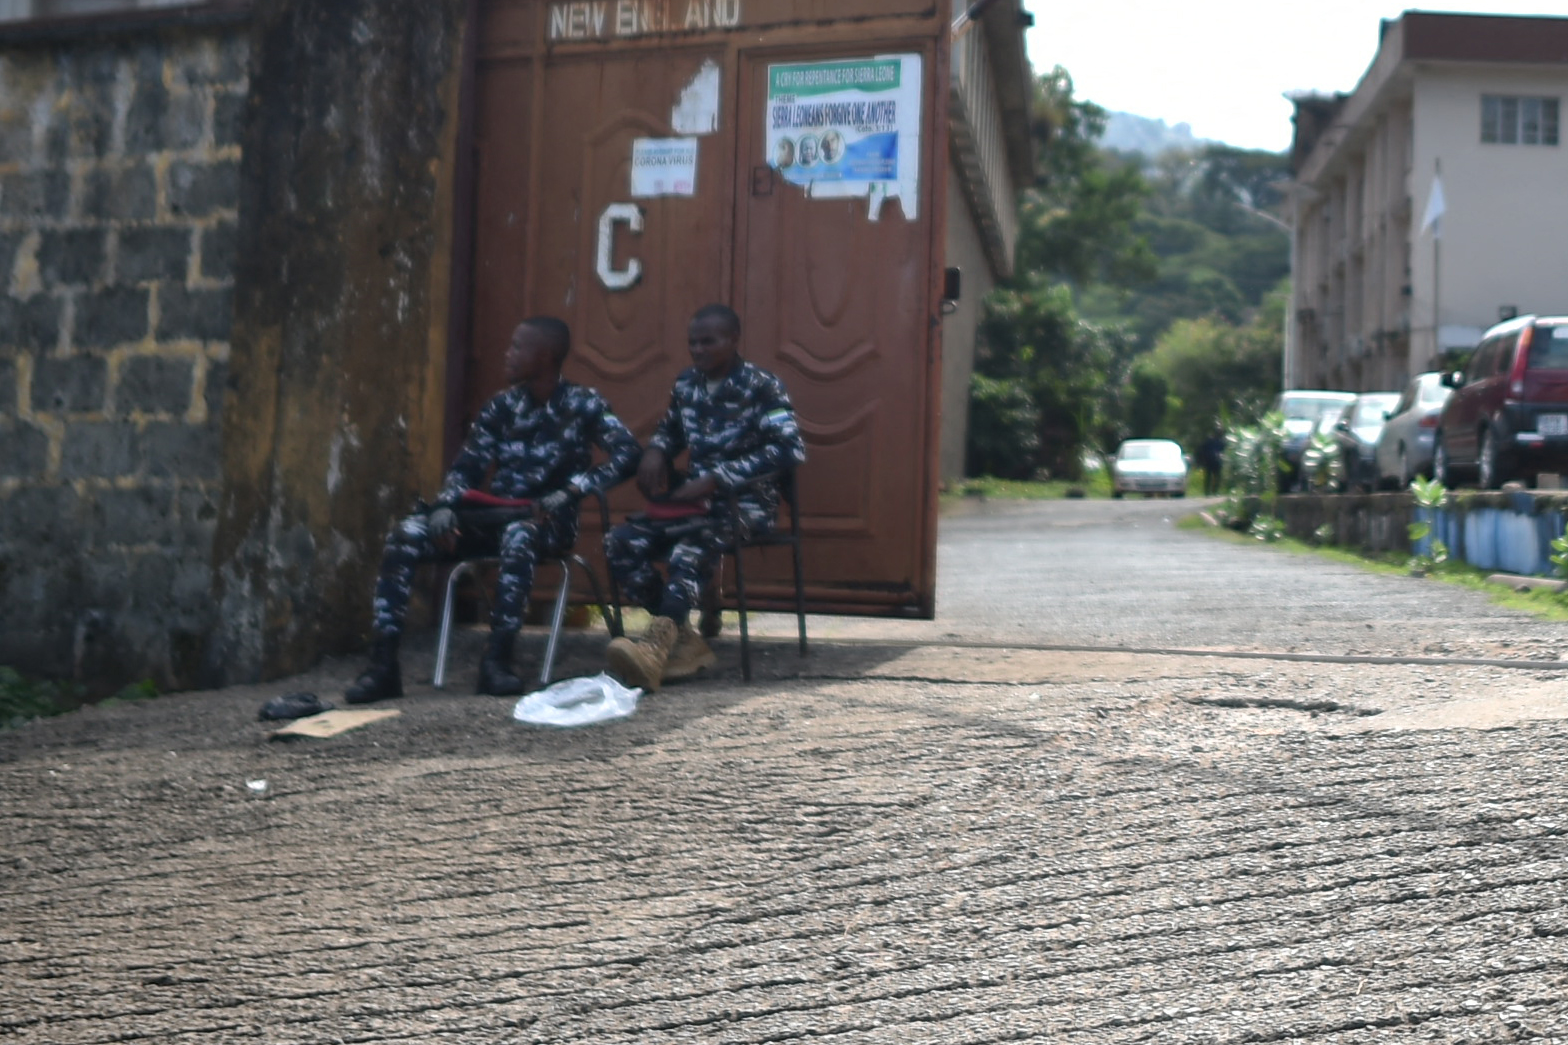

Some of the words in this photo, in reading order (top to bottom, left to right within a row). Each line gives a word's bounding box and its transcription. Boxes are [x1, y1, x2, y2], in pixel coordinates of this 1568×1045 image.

[551, 0, 606, 39] NEW
[793, 70, 804, 86] FOR
[805, 68, 841, 85] REPENTANCE
[842, 68, 853, 84] FOR
[854, 67, 875, 83] SIERRA
[875, 65, 895, 82] LEONE
[772, 105, 791, 129] SIERRA
[792, 103, 824, 128] LEONEANS
[824, 102, 851, 126] FORGIVE
[851, 101, 865, 125] ONE
[865, 100, 896, 125] ANOTHER
[634, 156, 667, 167] CORONA
[668, 155, 693, 165] VIRUS
[597, 202, 644, 287] C
